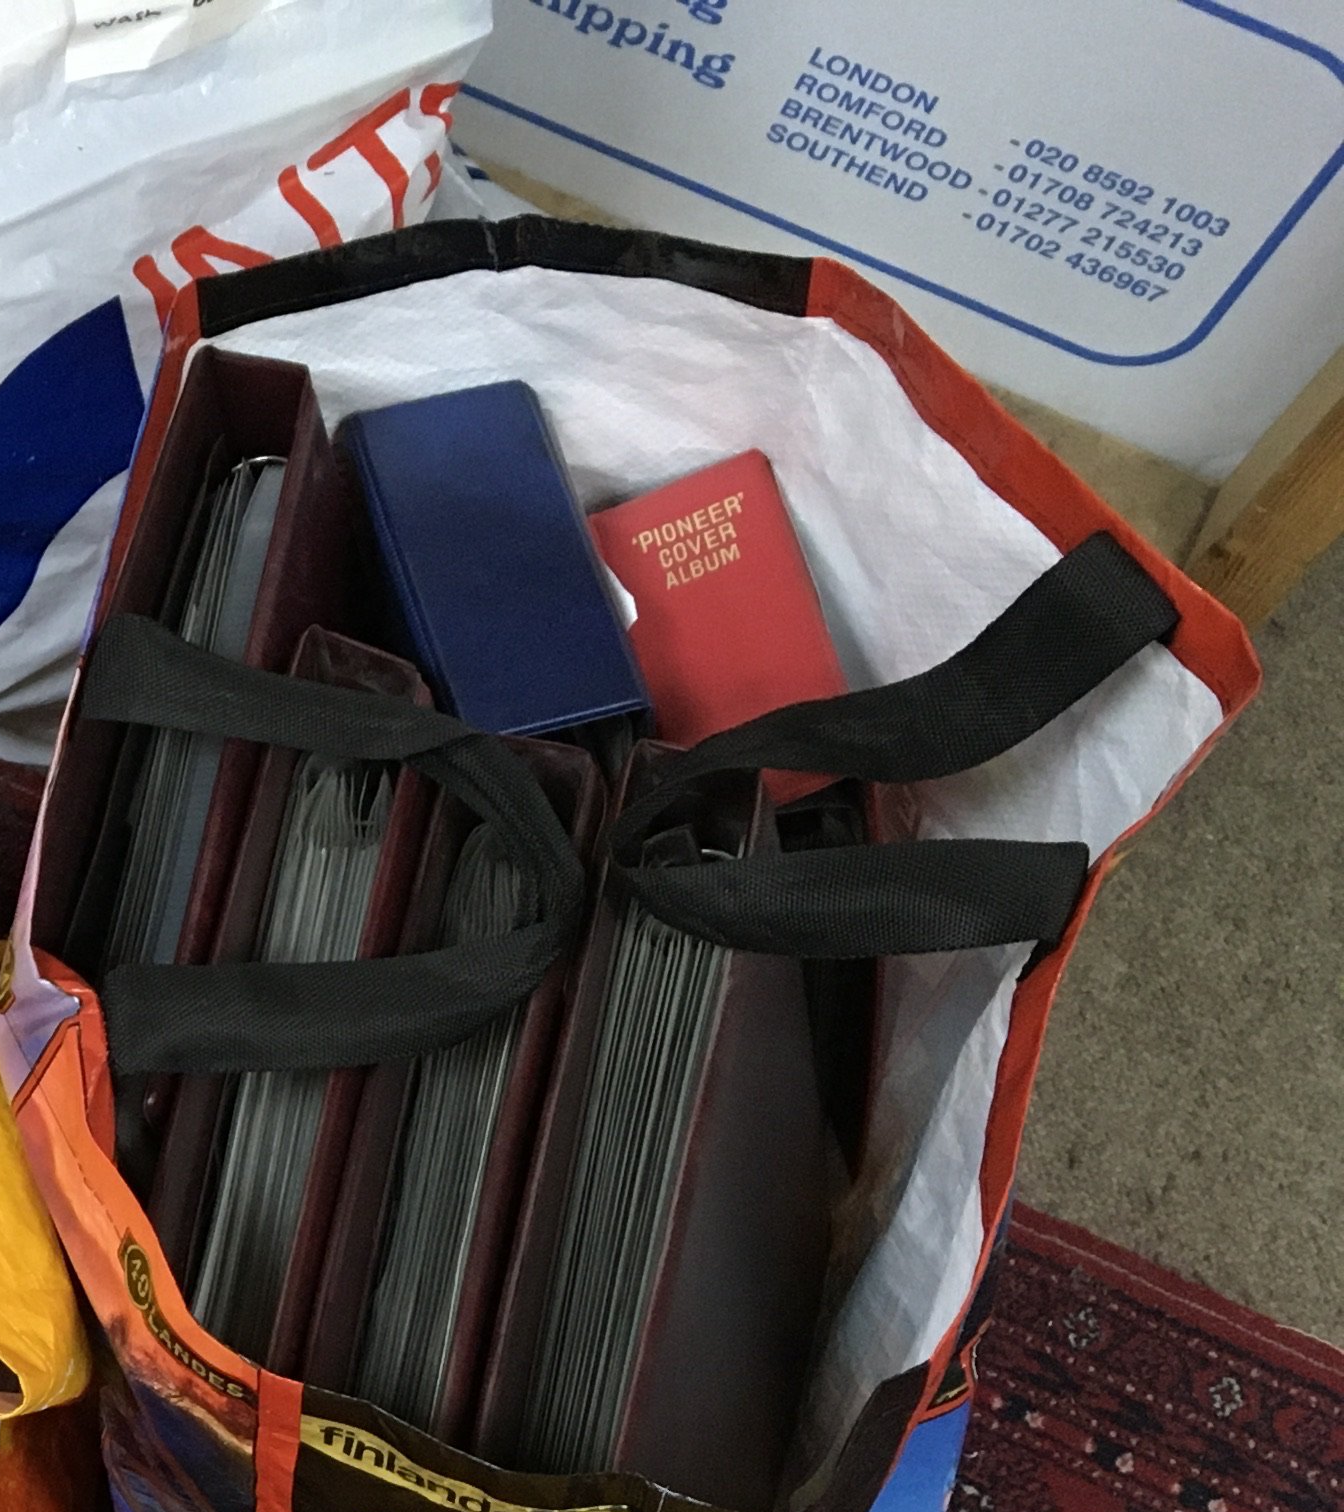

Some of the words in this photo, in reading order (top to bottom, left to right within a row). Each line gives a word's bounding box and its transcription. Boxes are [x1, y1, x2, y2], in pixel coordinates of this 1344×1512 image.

[94, 9, 162, 30] wash
[780, 98, 973, 191] BRENTWOOD
[1080, 227, 1186, 283] 215530
[794, 73, 948, 149] ROMFORD
[1104, 203, 1204, 259] 724213
[809, 47, 940, 115] LONDON
[1082, 164, 1155, 206] 8592
[1163, 197, 1230, 238] 1003
[766, 123, 929, 203] SOUTHEND
[1065, 251, 1169, 303] 436967
[659, 522, 737, 568] COVER
[667, 543, 741, 591] ALBUM
[148, 1306, 246, 1399] LANDES
